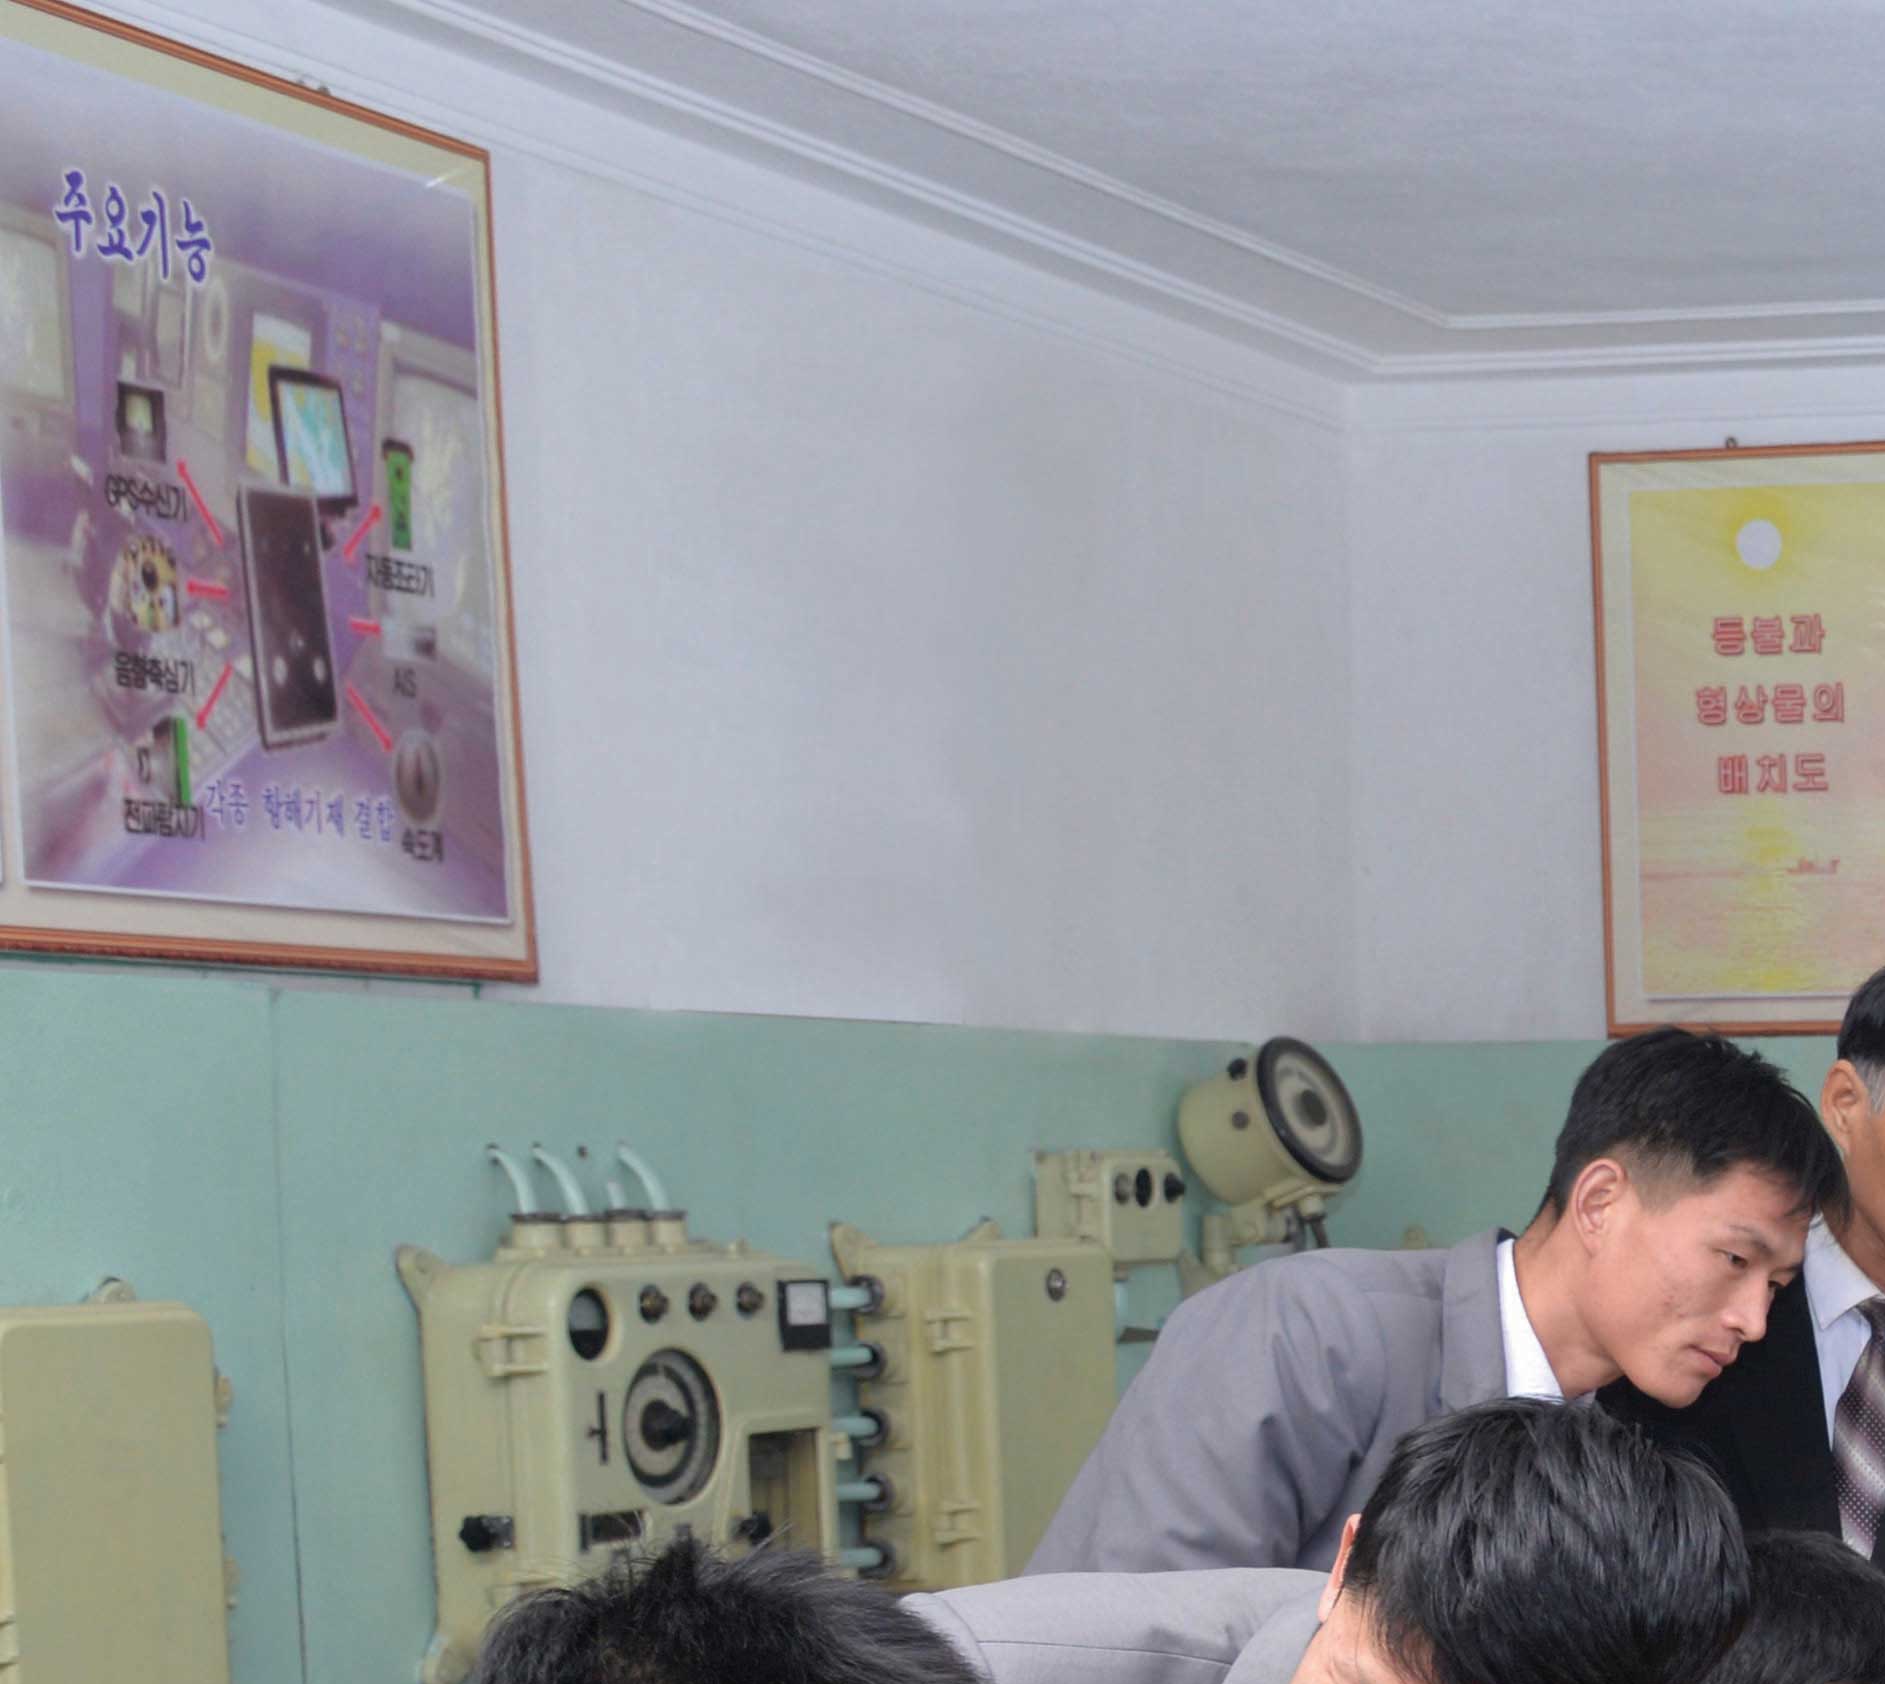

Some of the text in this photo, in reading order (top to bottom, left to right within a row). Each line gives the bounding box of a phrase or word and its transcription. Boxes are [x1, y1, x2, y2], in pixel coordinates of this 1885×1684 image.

[55, 171, 212, 283] 주요기능
[1712, 612, 1826, 657] 등불과
[1696, 681, 1845, 726] 형상물의
[1718, 753, 1829, 796] 배치도
